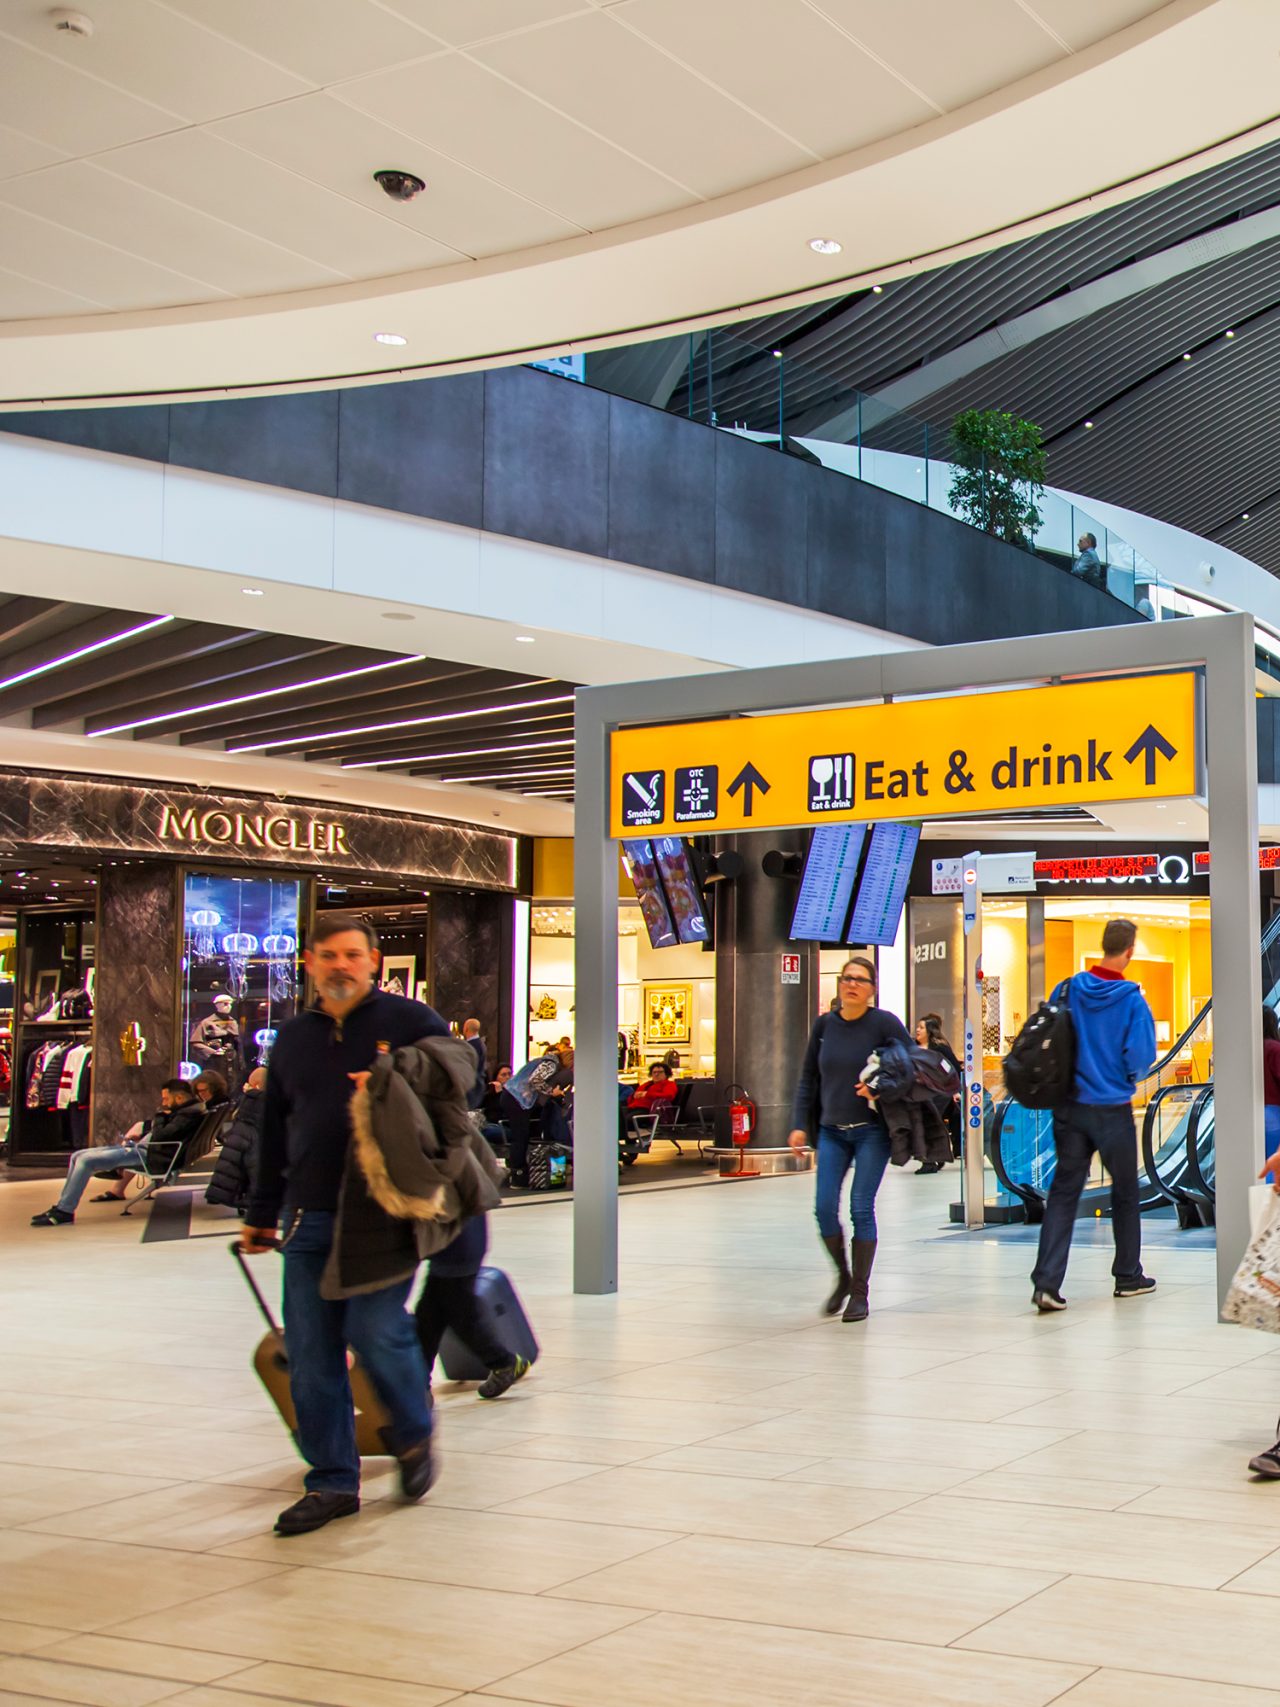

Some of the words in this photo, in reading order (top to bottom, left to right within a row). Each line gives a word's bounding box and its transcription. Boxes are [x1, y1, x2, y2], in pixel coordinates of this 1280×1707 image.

[689, 768, 704, 778] OTC
[865, 760, 929, 800] Eat
[944, 749, 976, 794] &
[991, 739, 1114, 790] drink
[811, 801, 823, 810] Eat
[824, 801, 831, 809] &
[831, 799, 851, 808] drink
[627, 808, 661, 820] Smoking
[676, 810, 715, 821] Parafarmacia
[635, 817, 652, 826] area
[159, 805, 351, 855] MONCLER
[1034, 859, 1084, 871] AEROPORTI
[1087, 858, 1096, 868] DI
[1100, 856, 1125, 867] ROMA
[1127, 856, 1157, 867] S.P.A.
[1052, 870, 1065, 879] NO
[1068, 867, 1109, 879] BAGGAGE
[1112, 865, 1143, 876] CARTS
